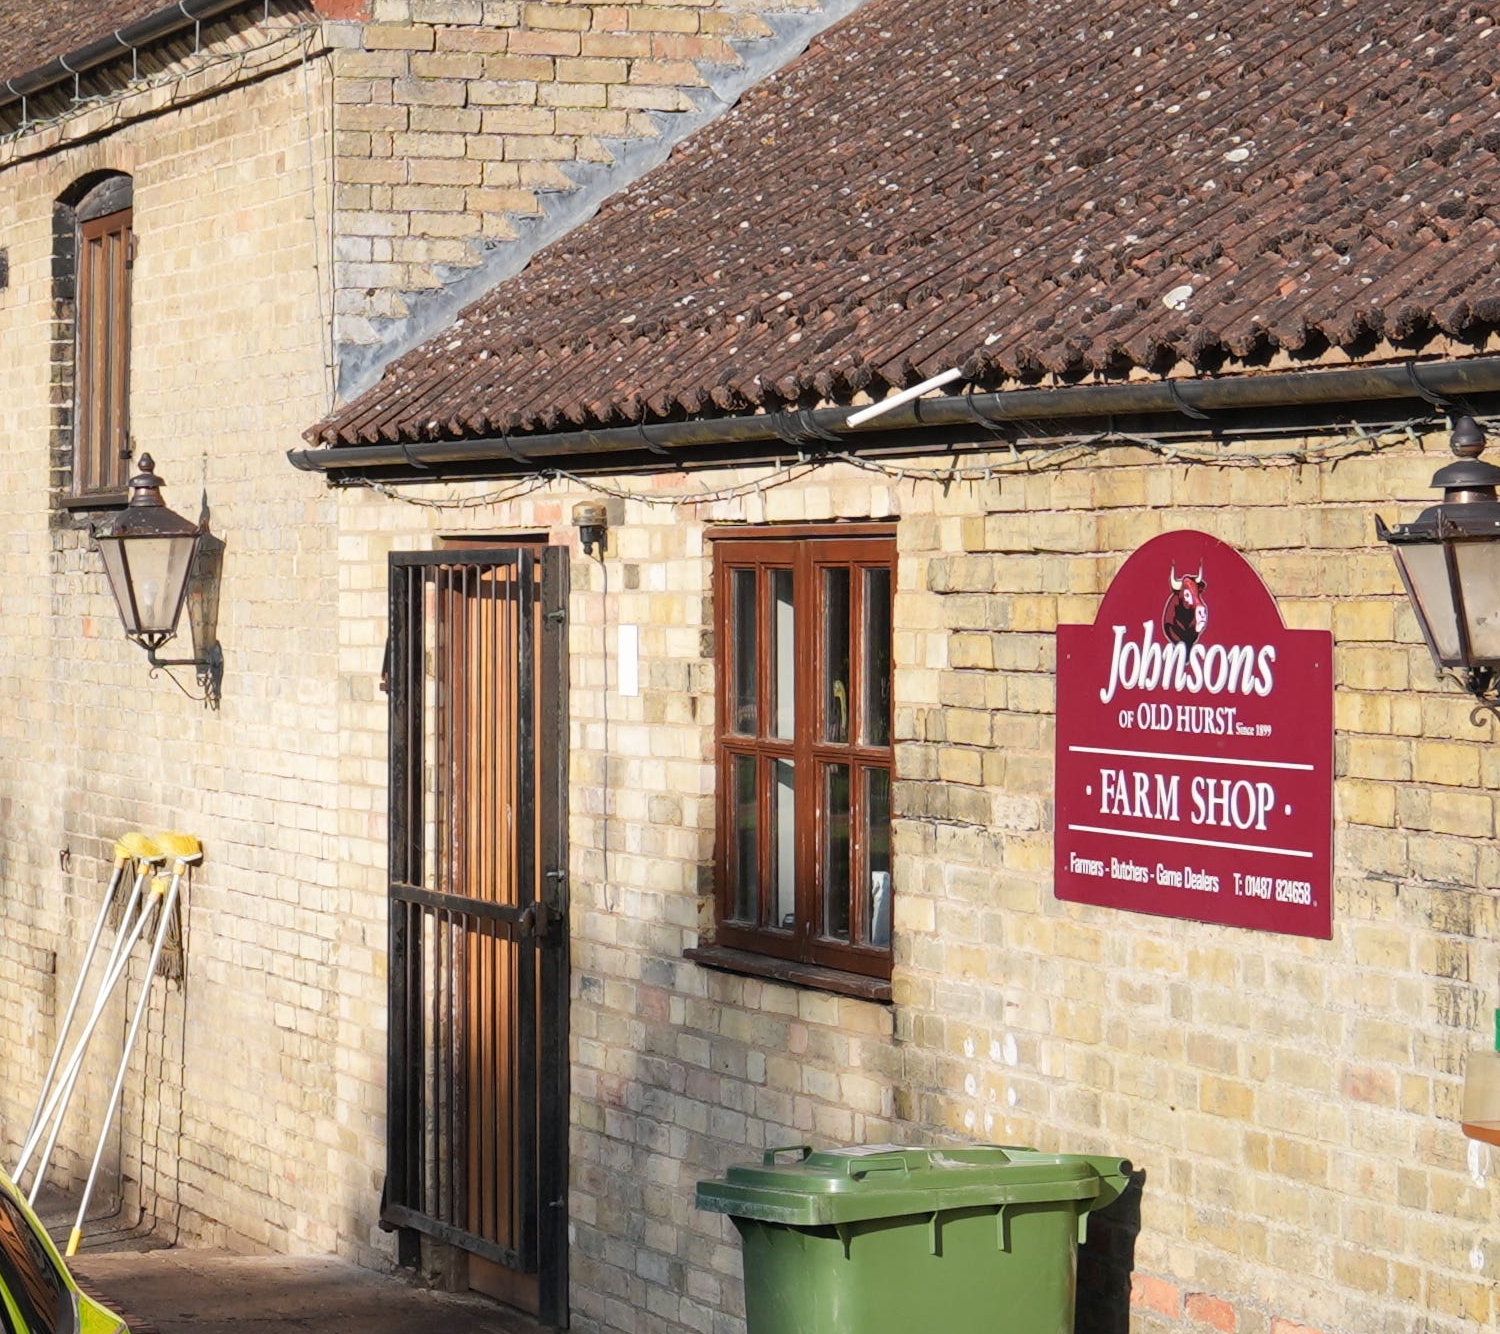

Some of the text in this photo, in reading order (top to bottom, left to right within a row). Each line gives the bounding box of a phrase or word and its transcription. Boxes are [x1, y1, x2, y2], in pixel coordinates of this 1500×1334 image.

[1100, 620, 1276, 704] Johnsons
[1119, 703, 1272, 737] OF OLD HURST Since 1899
[1100, 769, 1275, 830] FARM SHOP
[1070, 852, 1103, 877] Farmers
[1111, 857, 1148, 883] Butchers
[1156, 864, 1182, 887] Game
[1184, 867, 1219, 892] Dealers
[1234, 873, 1243, 895] T:
[1245, 875, 1272, 900] 01487
[1276, 879, 1311, 905] 824658
